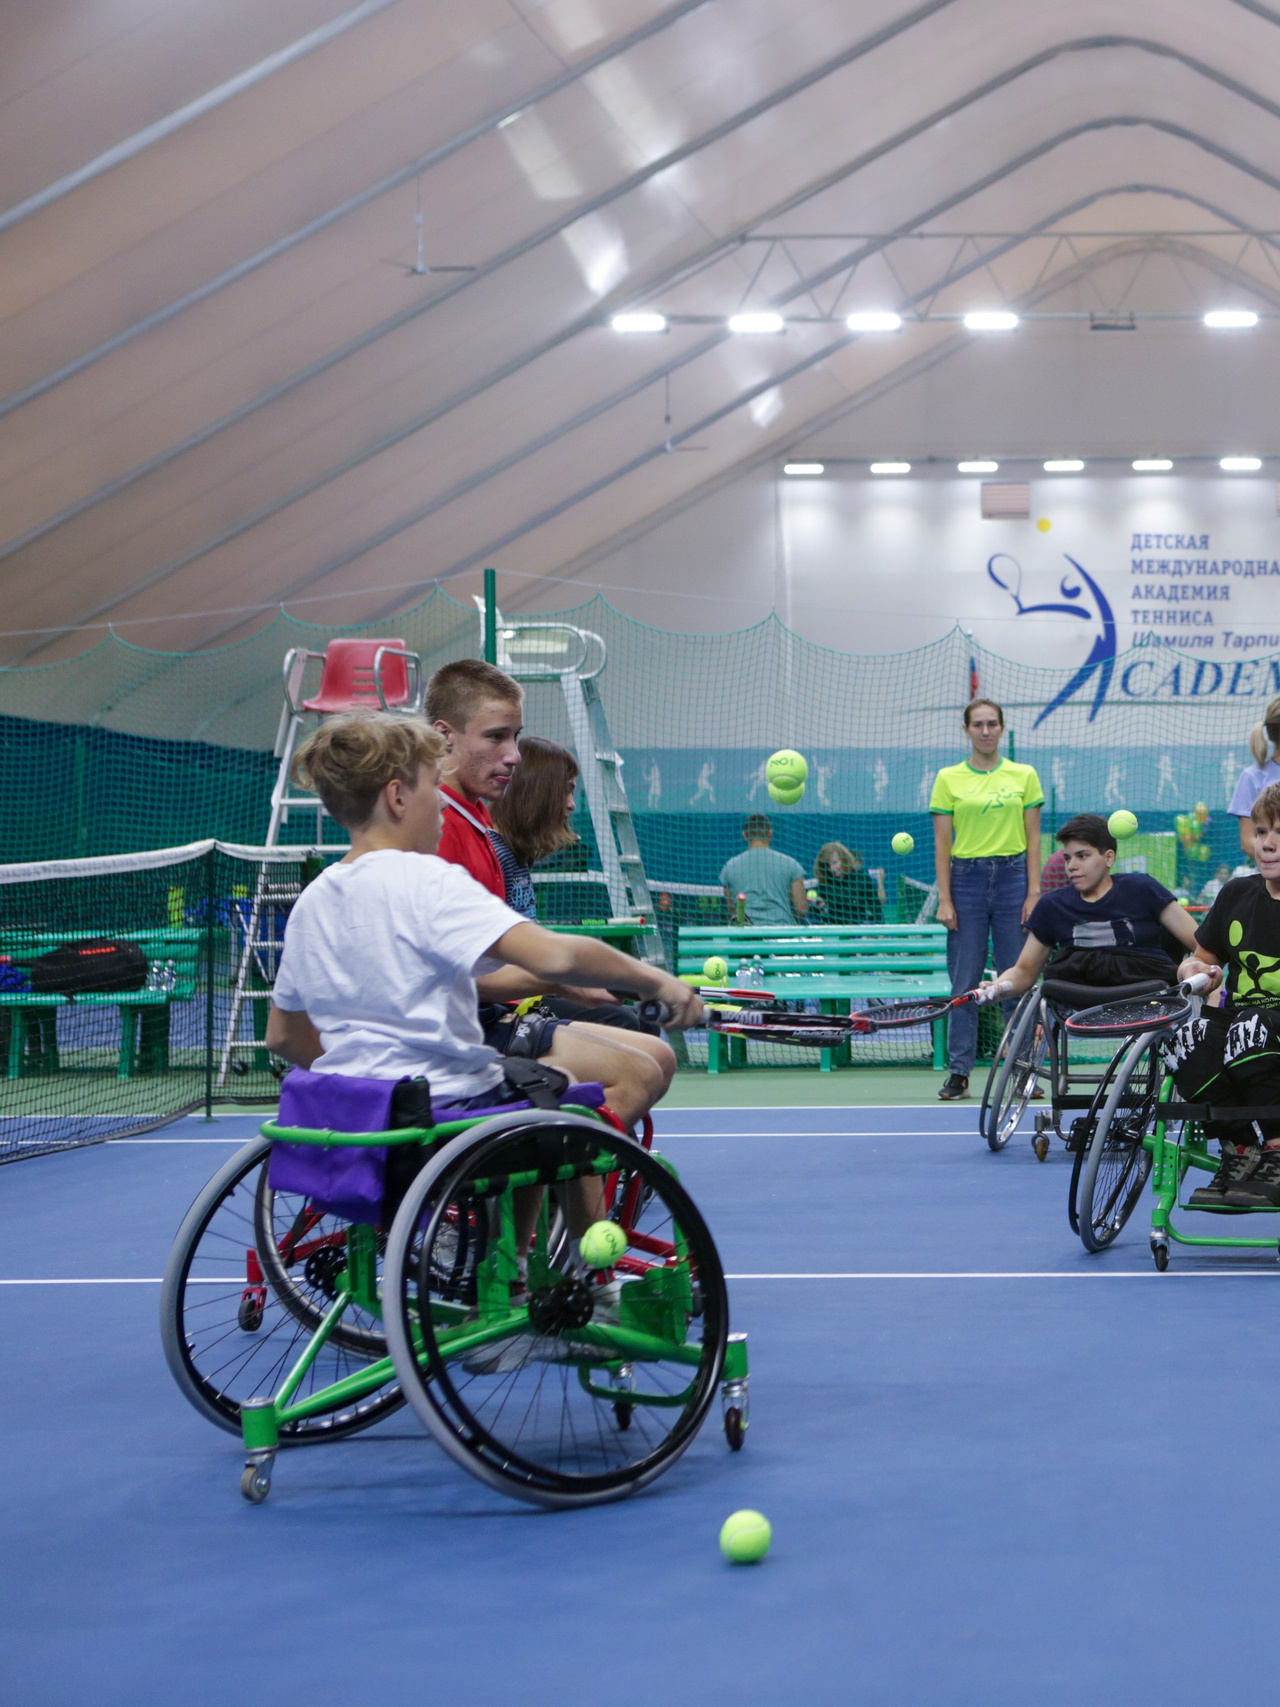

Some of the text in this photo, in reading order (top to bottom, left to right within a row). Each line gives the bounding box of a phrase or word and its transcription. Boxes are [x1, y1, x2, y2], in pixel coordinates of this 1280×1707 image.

[1131, 533, 1209, 551] ДЕТСКАЯ
[1131, 585, 1230, 603] АКАДЕМИЯ
[1131, 609, 1214, 625] ТЕННИСА
[1132, 631, 1214, 648] Шамиля
